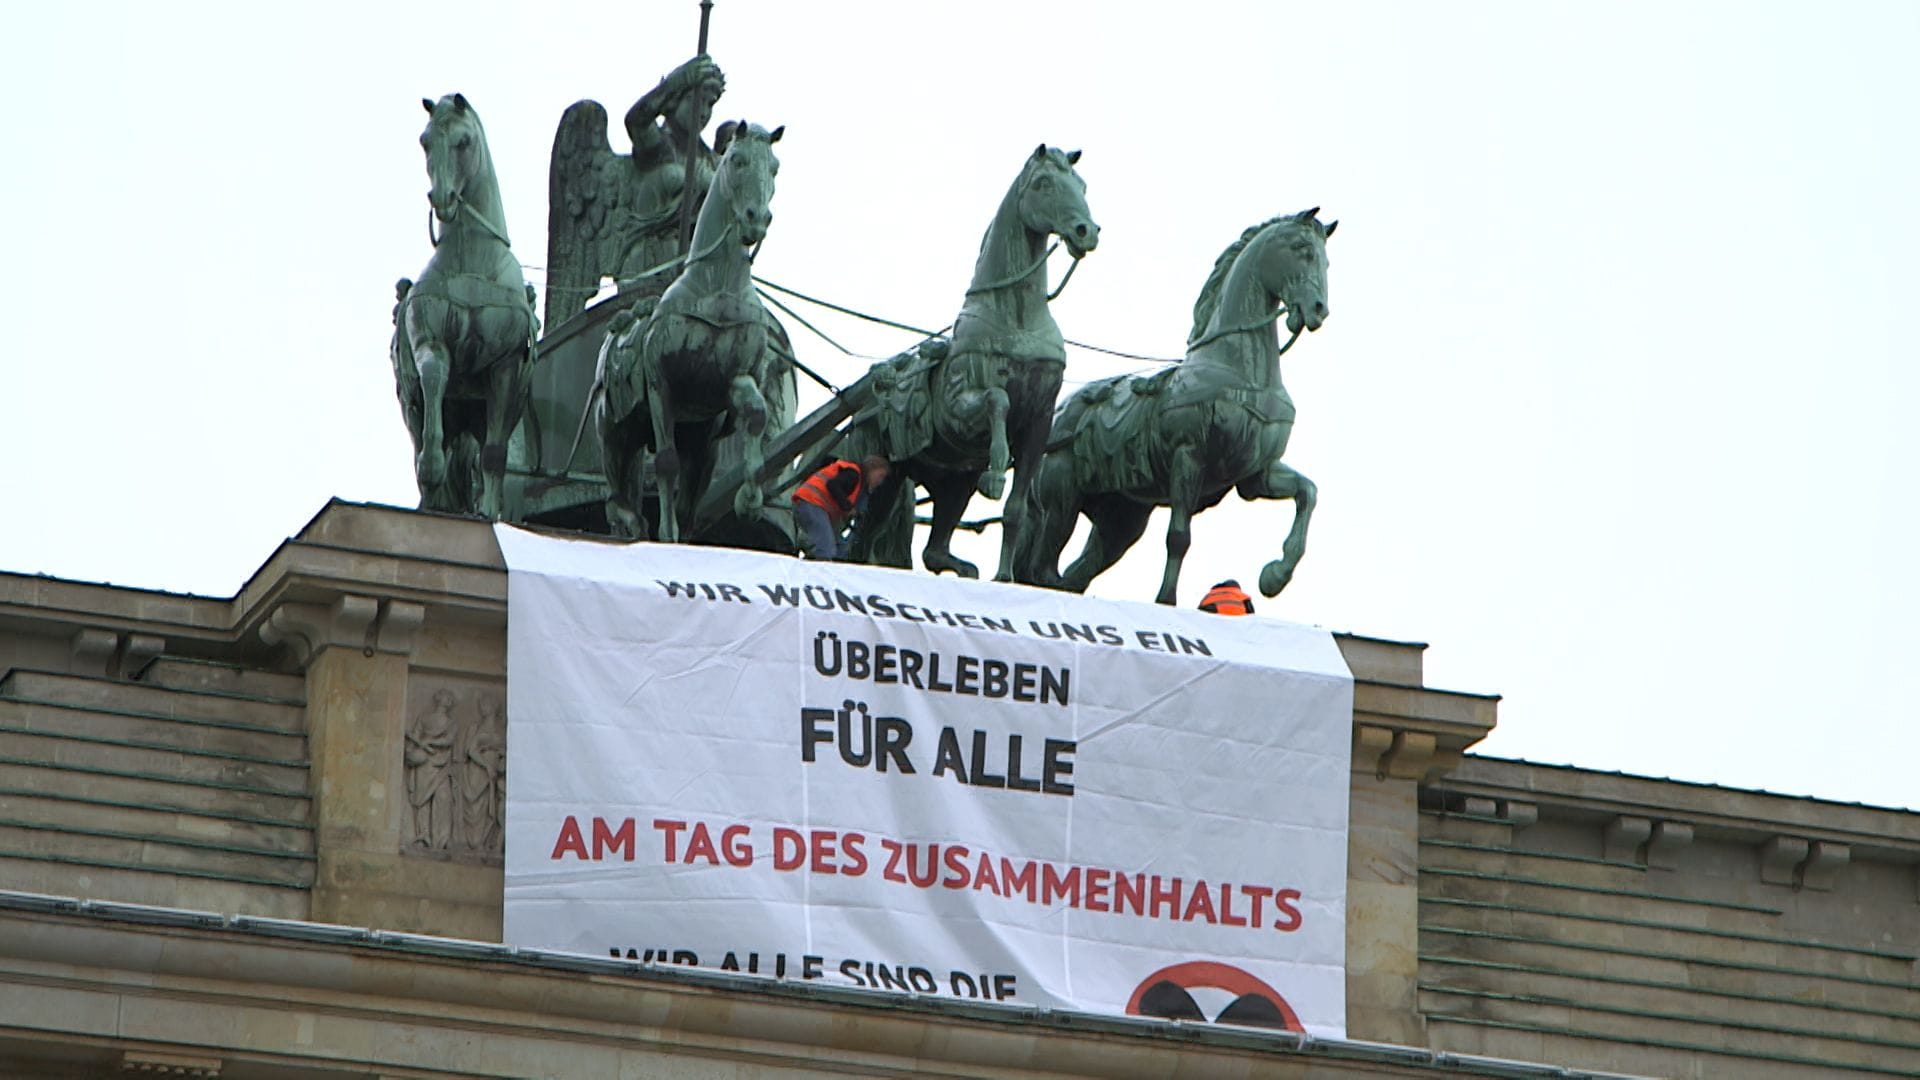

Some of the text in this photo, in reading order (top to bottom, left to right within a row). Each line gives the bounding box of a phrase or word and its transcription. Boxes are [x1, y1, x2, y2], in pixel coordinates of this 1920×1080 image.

[655, 579, 1213, 657] WIR WÜNSCHEN UNS EIN
[813, 631, 1071, 707] ÜBERLEBEN
[800, 699, 1078, 797] FÜR ALLE
[551, 815, 1304, 933] AM TAG DES ZUSAMMENHALTS
